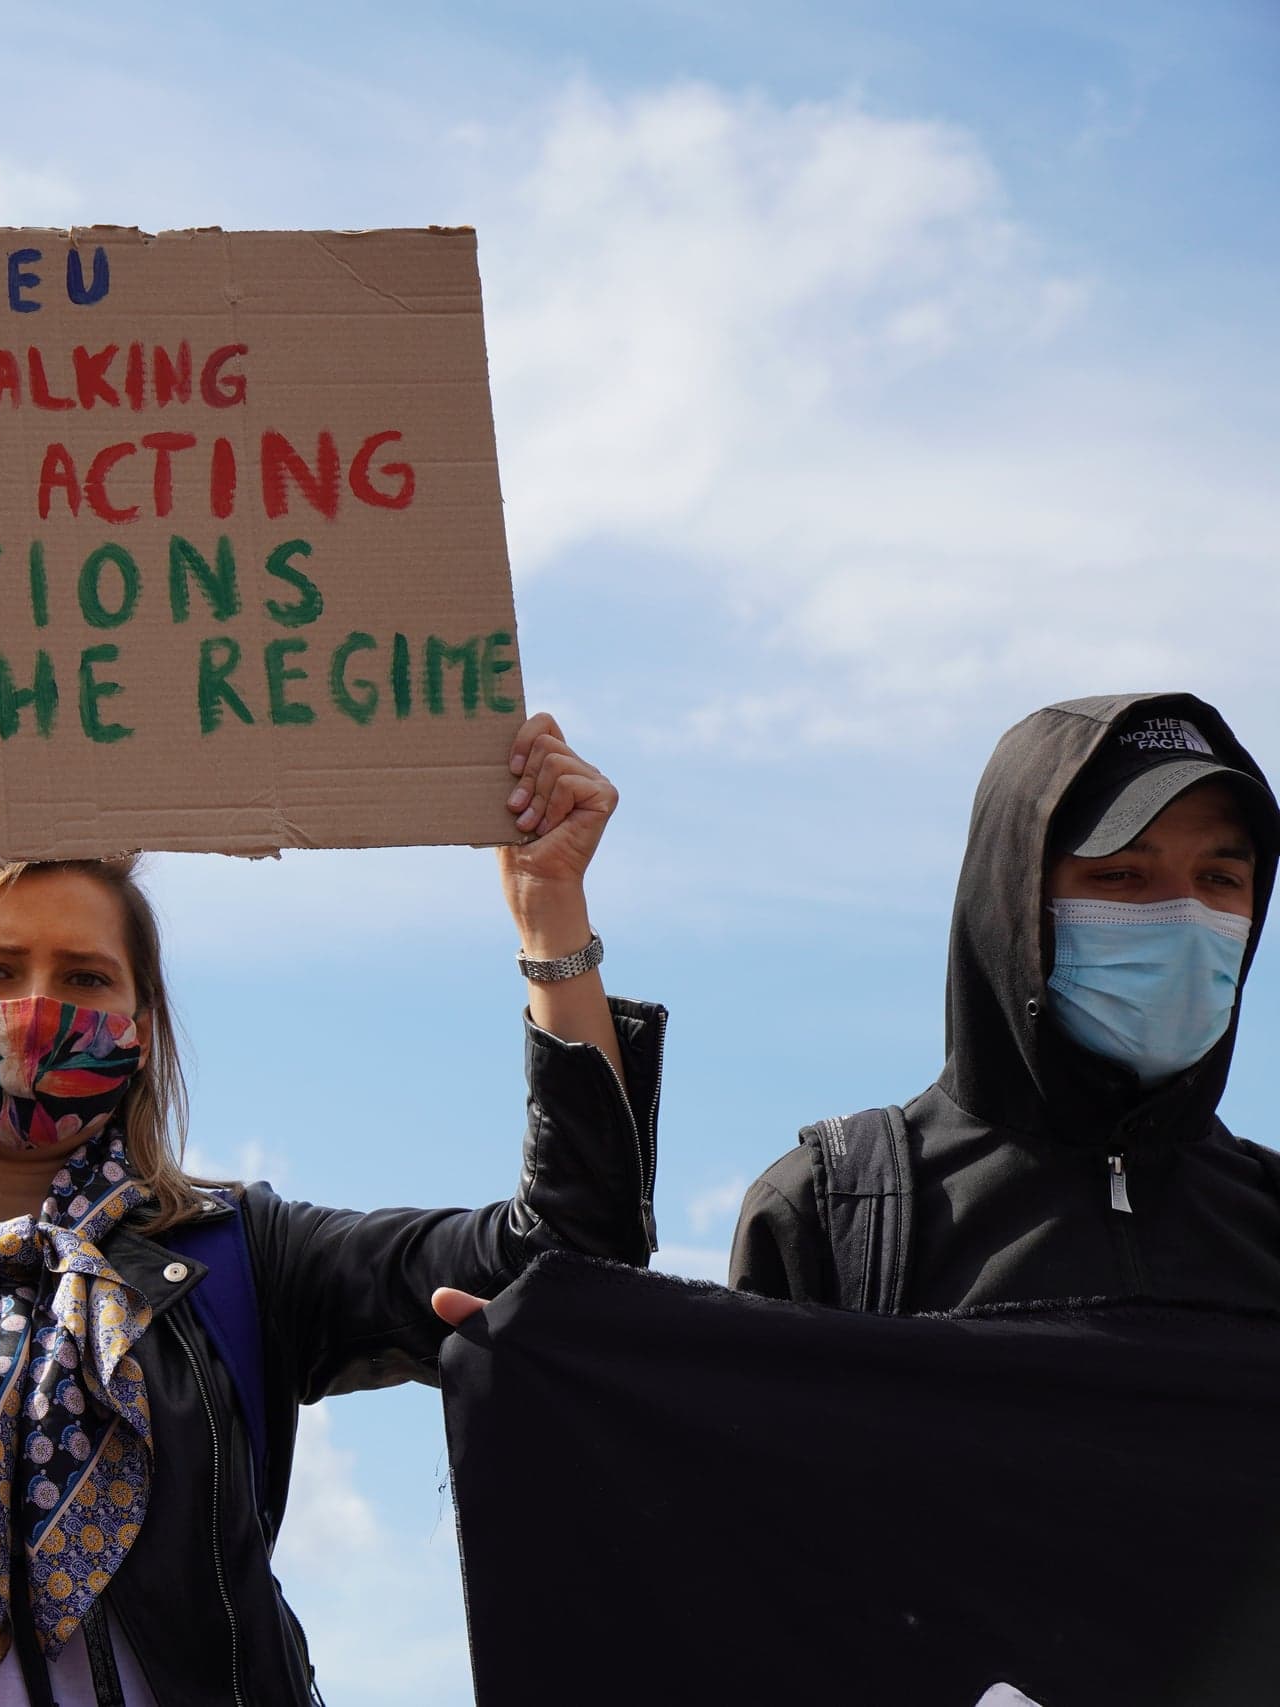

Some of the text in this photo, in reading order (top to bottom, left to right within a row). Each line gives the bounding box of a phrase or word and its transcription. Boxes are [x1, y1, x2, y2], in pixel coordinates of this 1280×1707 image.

[7, 246, 111, 313] EU
[37, 430, 416, 524] ACTING
[197, 631, 518, 736] REGIME
[1119, 729, 1184, 744] NORTH
[1144, 717, 1180, 730] THE
[1137, 739, 1186, 750] FACE
